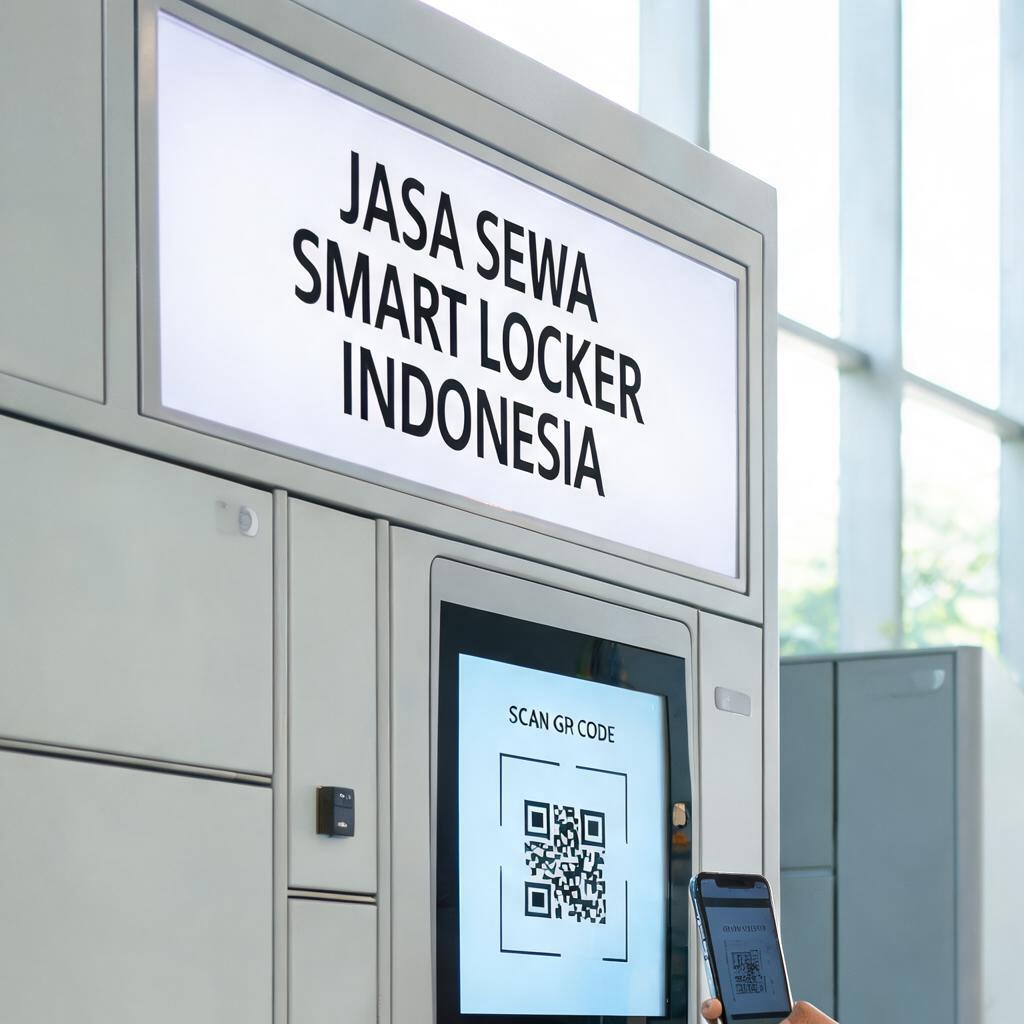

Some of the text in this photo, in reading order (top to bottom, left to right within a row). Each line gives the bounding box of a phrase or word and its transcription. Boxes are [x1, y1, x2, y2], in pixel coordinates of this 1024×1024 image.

[339, 150, 598, 323] JASA SEWA
[292, 228, 645, 425] SMART LOCKER
[343, 340, 605, 497] INDONESIA
[509, 705, 549, 731] SCAN
[577, 719, 616, 744] CODE
